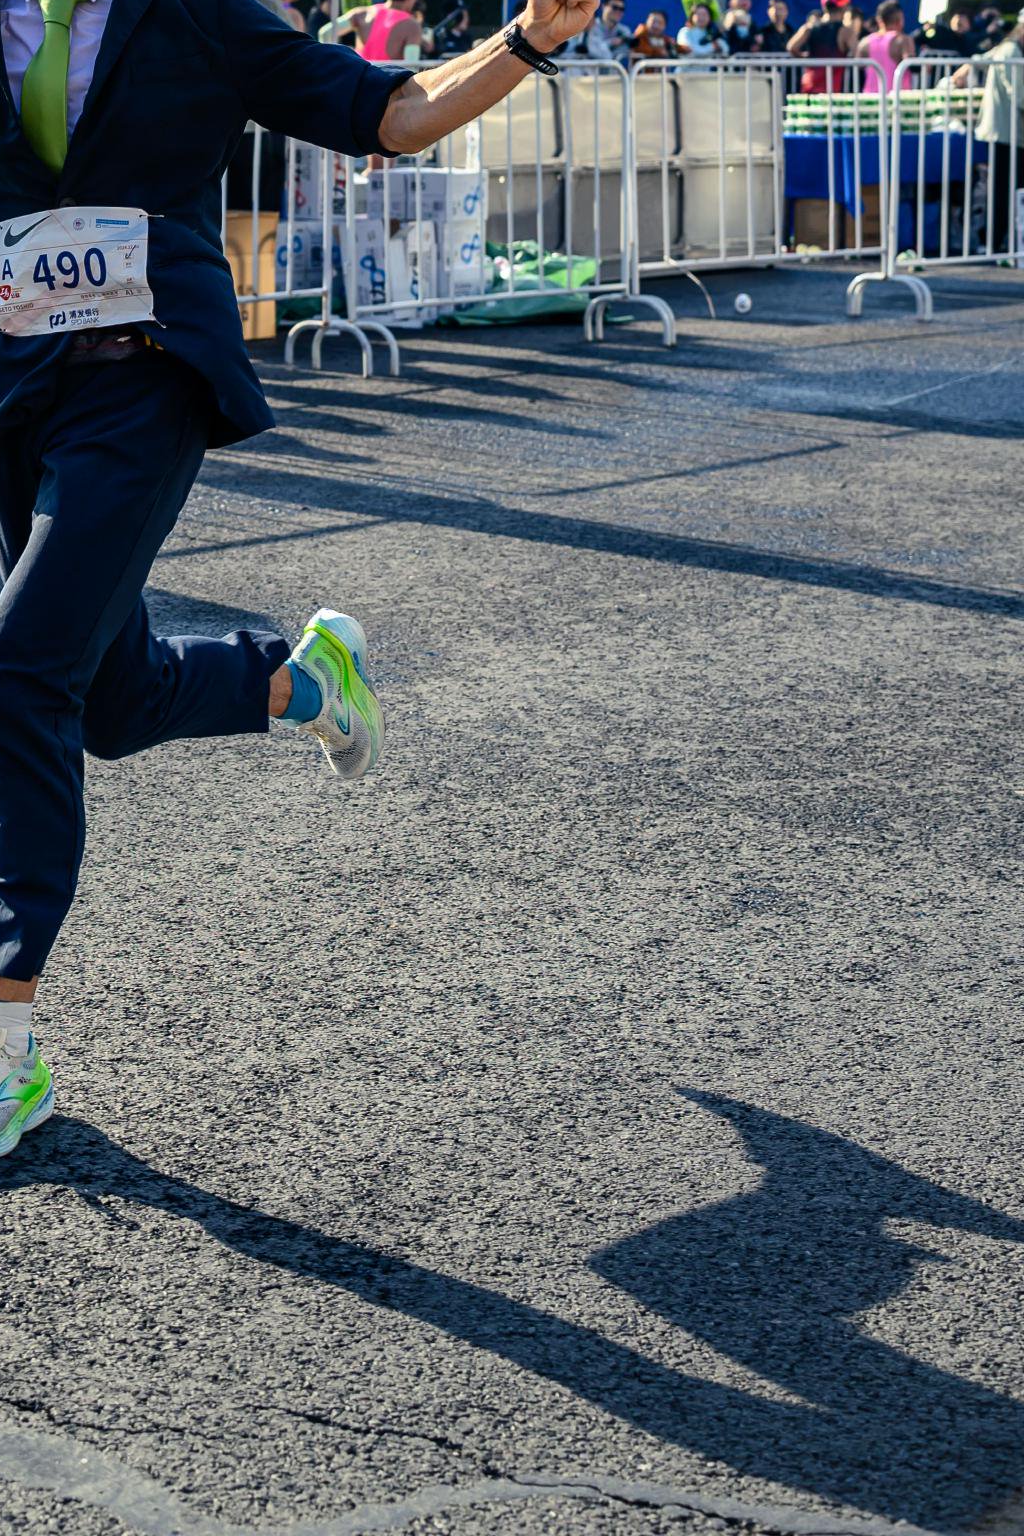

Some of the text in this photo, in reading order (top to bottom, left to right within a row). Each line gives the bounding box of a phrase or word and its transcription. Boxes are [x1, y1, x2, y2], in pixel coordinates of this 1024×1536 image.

[2, 258, 14, 281] A
[32, 247, 107, 291] 490
[69, 307, 100, 320] 浦发银行
[83, 316, 101, 325] BANK
